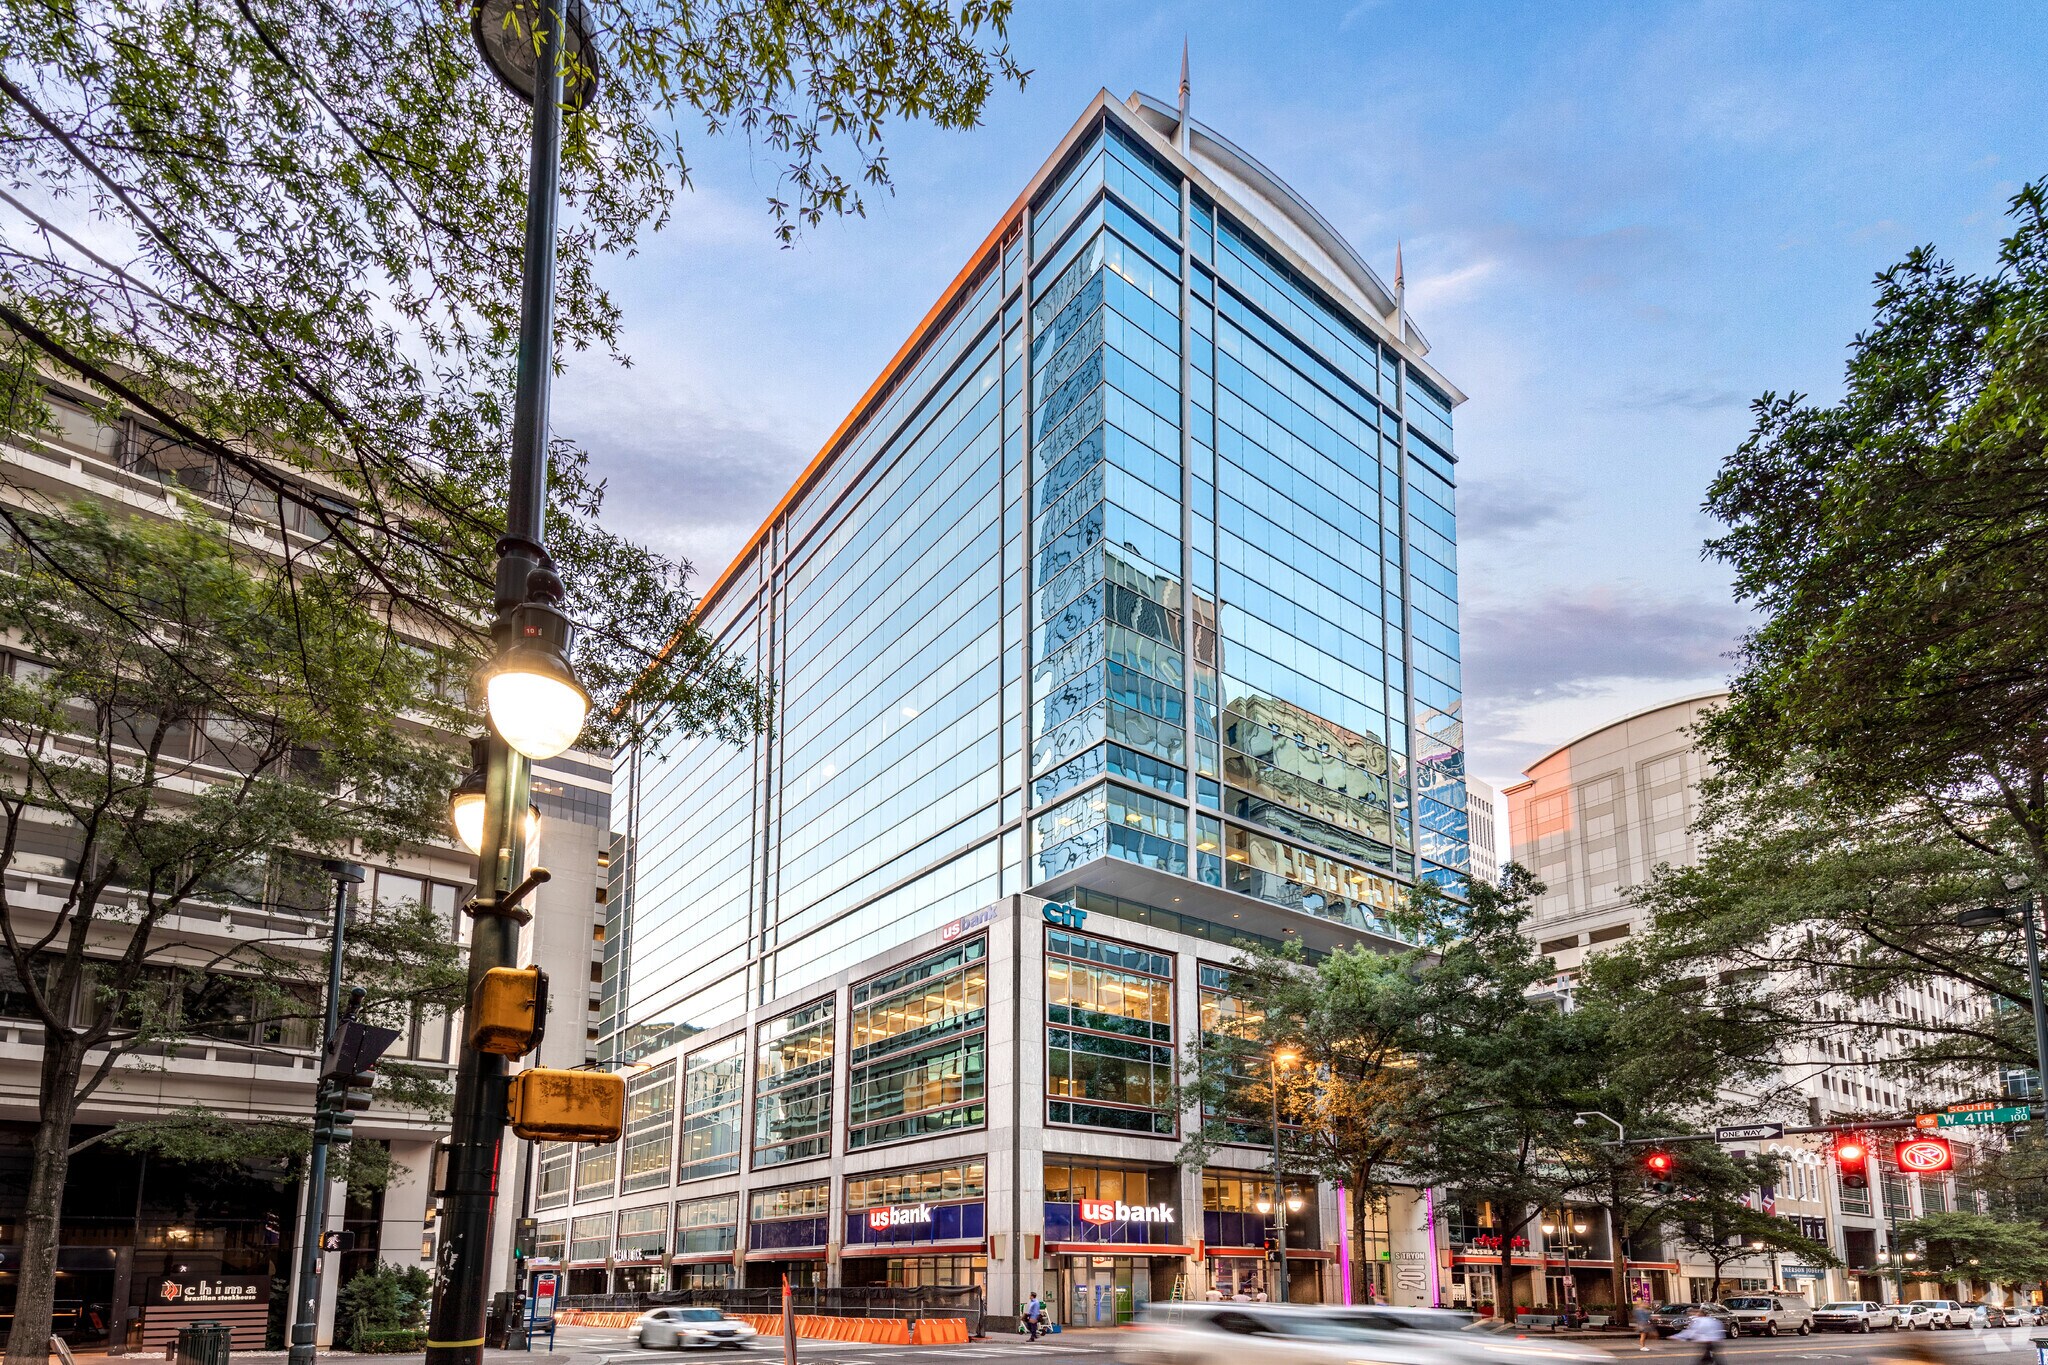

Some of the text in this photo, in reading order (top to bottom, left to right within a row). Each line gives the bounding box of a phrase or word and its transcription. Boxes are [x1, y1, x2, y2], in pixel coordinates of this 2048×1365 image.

[1949, 1102, 1994, 1113] SOUTH
[2015, 1106, 2026, 1114] ST
[1942, 1111, 1995, 1125] W. 4TH
[2010, 1113, 2028, 1122] 100
[1722, 1129, 1761, 1139] ONE WAY
[1402, 1252, 1425, 1260] TRYON
[1396, 1264, 1426, 1290] 201
[184, 1280, 257, 1295] chima
